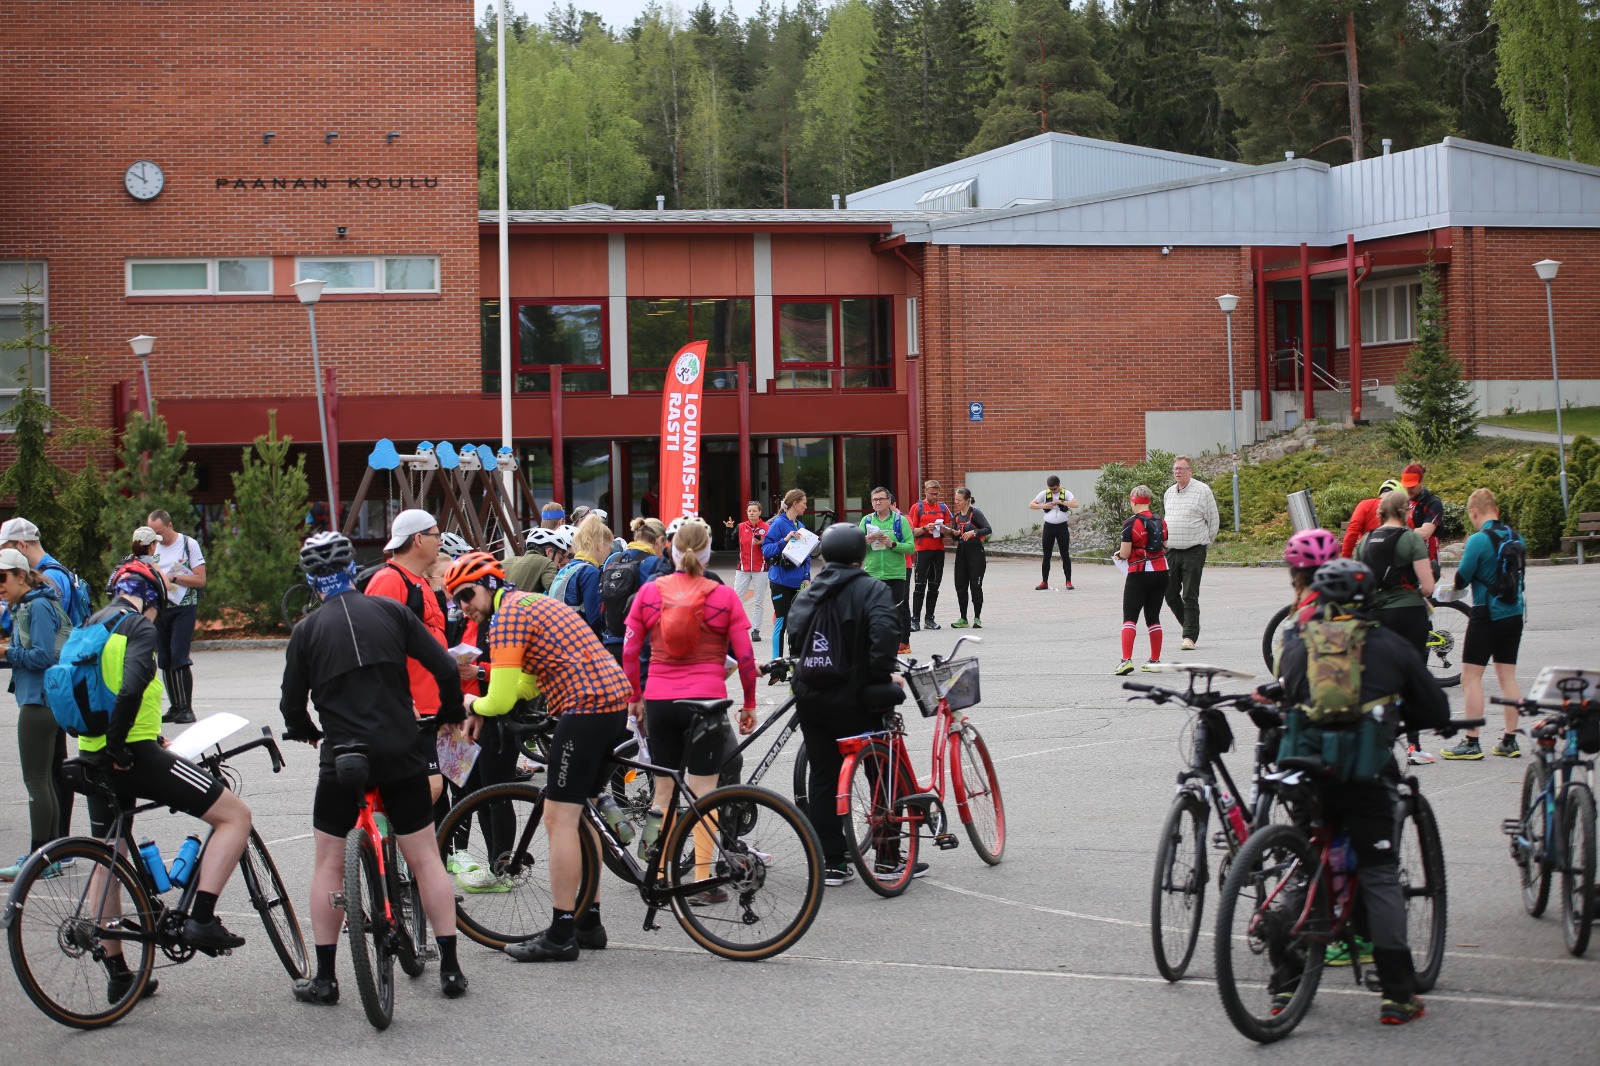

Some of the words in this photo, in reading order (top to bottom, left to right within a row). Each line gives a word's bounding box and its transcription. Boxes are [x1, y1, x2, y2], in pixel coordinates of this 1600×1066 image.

[215, 178, 327, 189] PAANAN
[348, 177, 438, 189] KOULU
[666, 392, 682, 450] RASTI
[803, 656, 833, 667] NEPRA
[557, 750, 571, 788] CRAFT
